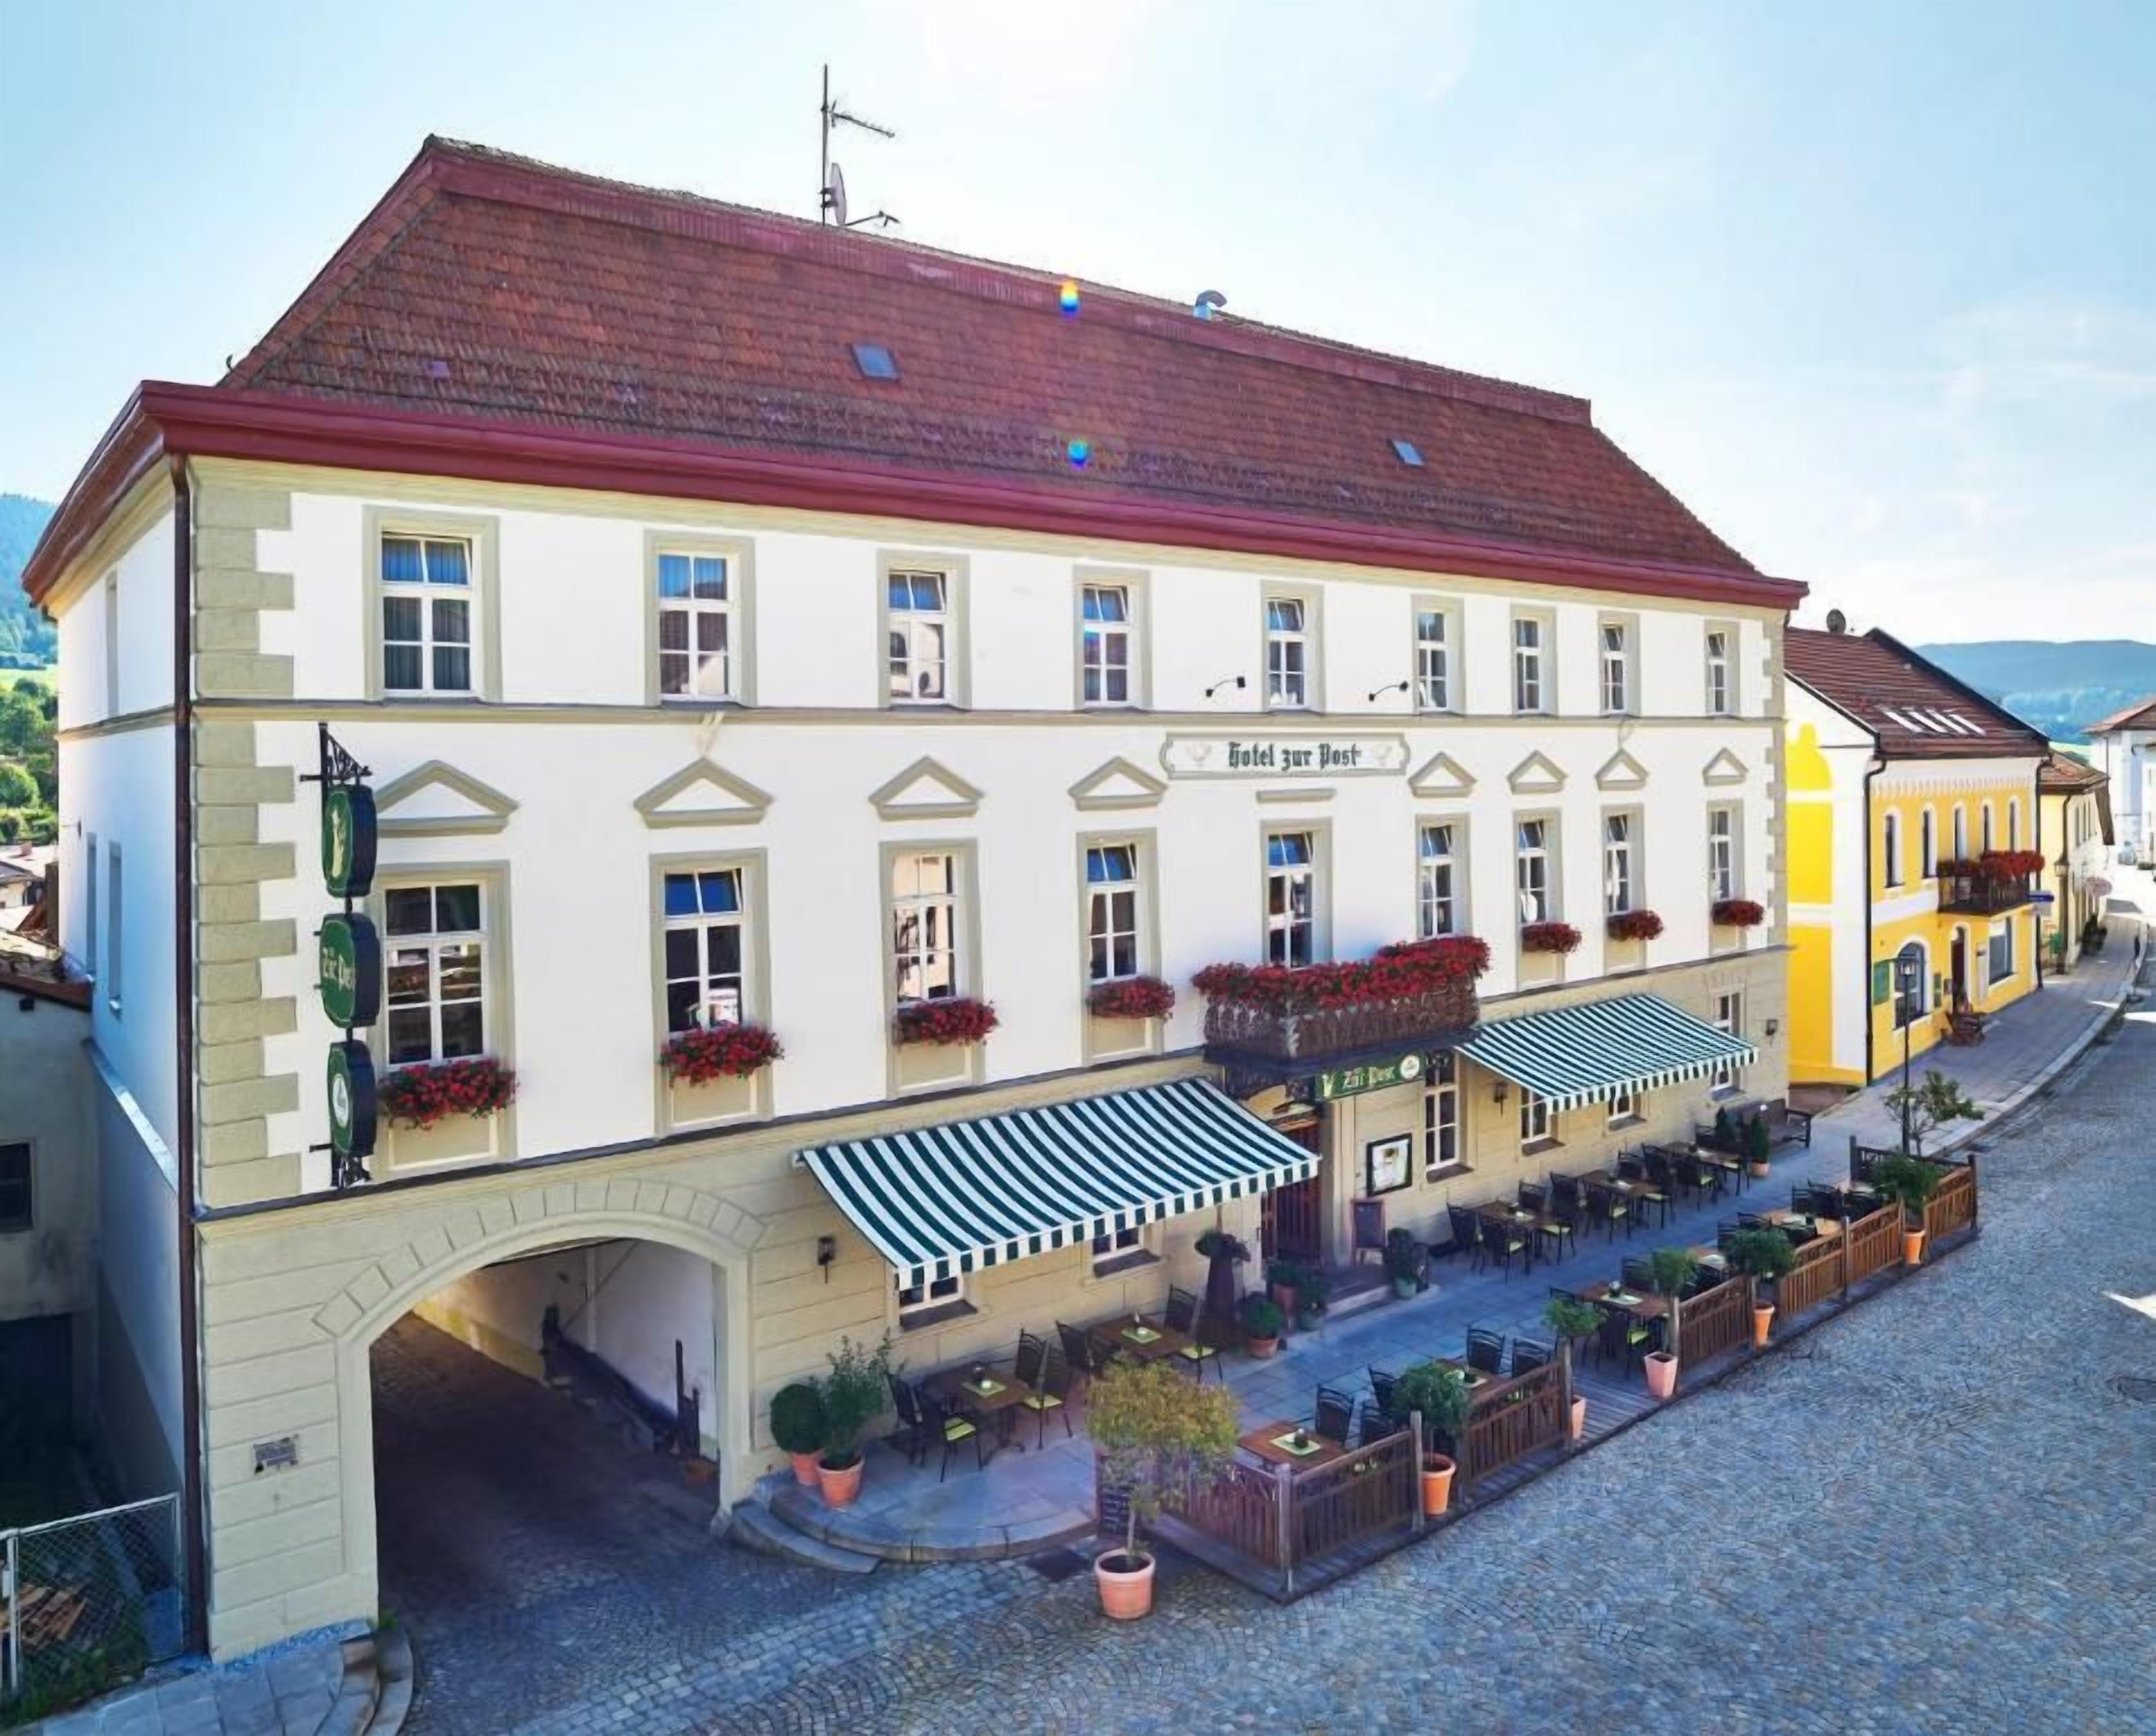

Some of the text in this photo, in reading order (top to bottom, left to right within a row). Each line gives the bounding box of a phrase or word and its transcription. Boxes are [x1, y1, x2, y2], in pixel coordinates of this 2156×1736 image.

[1229, 741, 1362, 771] Hotel zur Post
